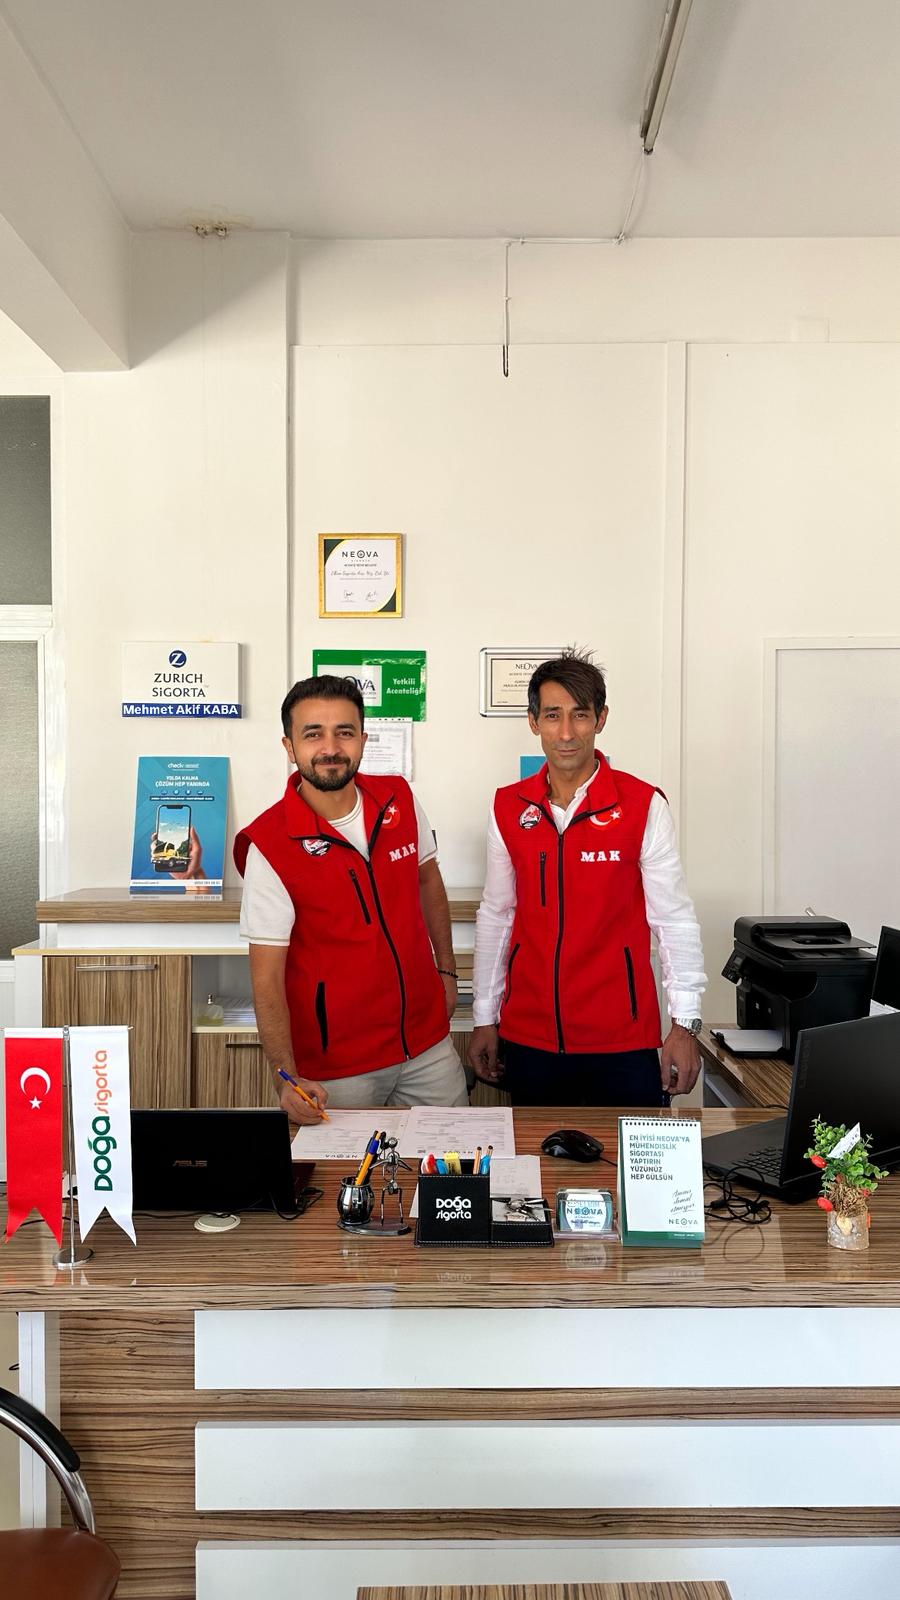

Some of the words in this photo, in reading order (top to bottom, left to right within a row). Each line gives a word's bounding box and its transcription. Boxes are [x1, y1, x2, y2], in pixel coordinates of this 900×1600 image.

[342, 550, 379, 559] NEOVA
[153, 673, 203, 684] ZURICH
[392, 678, 416, 686] Yetkili
[123, 704, 173, 715] Mehmet
[175, 704, 200, 715] Akif
[203, 705, 238, 715] KABA
[389, 843, 417, 862] MAK
[581, 850, 620, 862] MAK
[92, 1049, 113, 1114] sigorta
[656, 1135, 690, 1143] NEOVA'YA
[630, 1165, 663, 1173] YÜZÜNÜZ
[646, 1173, 673, 1181] GÜLSÜN
[435, 1210, 472, 1221] sigorta
[567, 1207, 603, 1215] NEOVA
